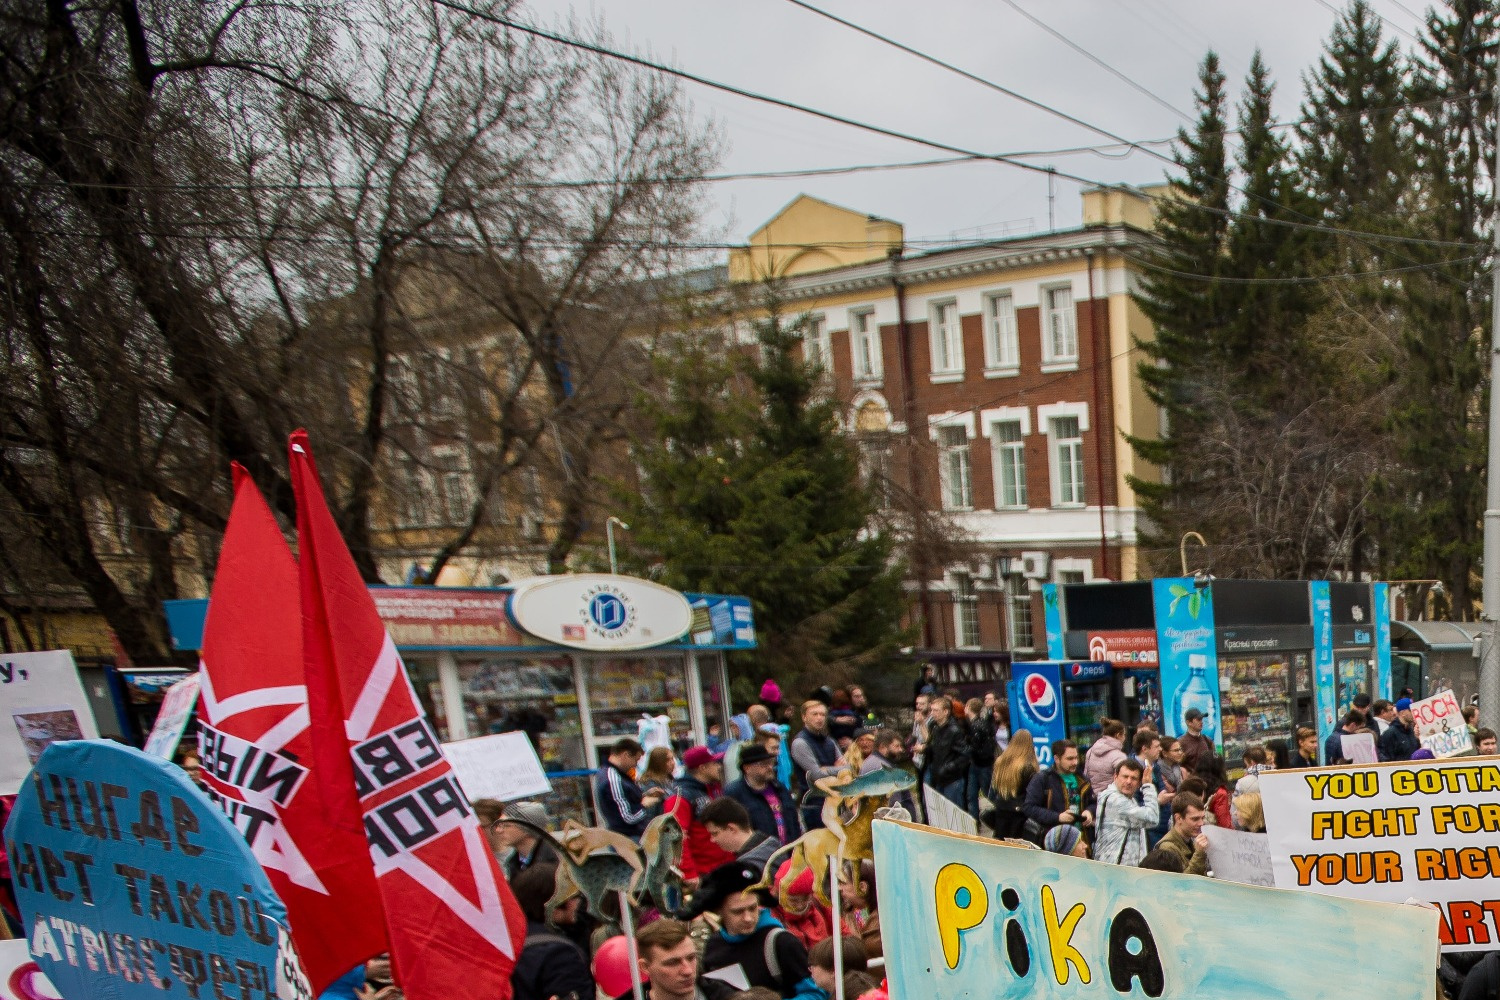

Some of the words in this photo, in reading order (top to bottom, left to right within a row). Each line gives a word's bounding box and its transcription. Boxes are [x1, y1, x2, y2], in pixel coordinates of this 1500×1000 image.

[1083, 664, 1105, 675] pepsi
[1304, 771, 1379, 800] YOU
[1311, 807, 1420, 840] FIGHT
[1290, 851, 1403, 886] YOUR
[114, 863, 275, 946] ТАКОЙ
